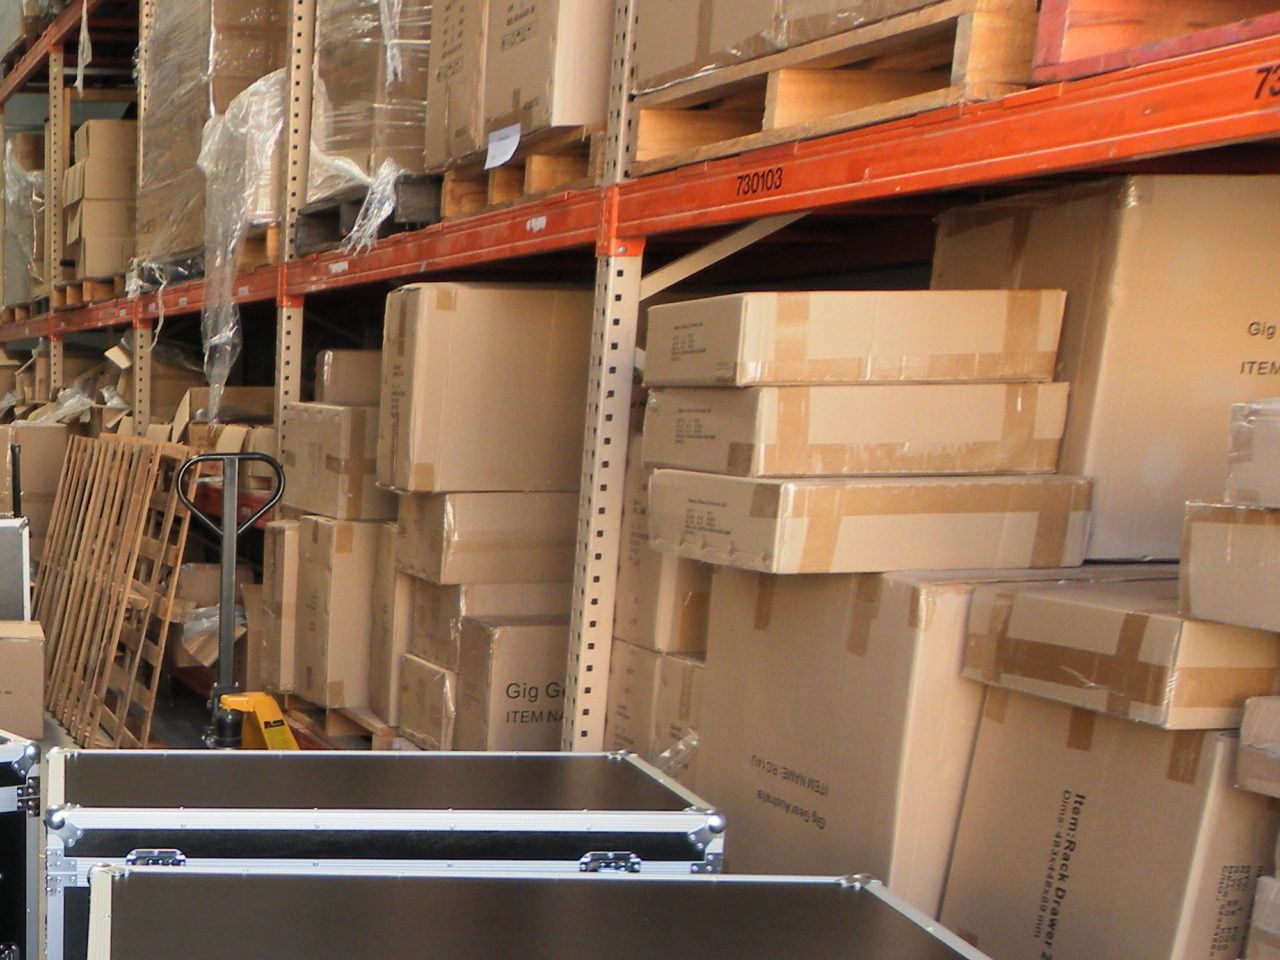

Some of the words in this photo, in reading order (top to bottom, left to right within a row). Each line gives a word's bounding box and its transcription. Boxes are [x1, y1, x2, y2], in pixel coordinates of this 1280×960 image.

[736, 167, 784, 197] 730103
[1247, 320, 1276, 341] Gig
[506, 682, 539, 703] Gig
[545, 681, 566, 699] G
[506, 710, 543, 723] ITEM
[1043, 886, 1067, 949] Drawer
